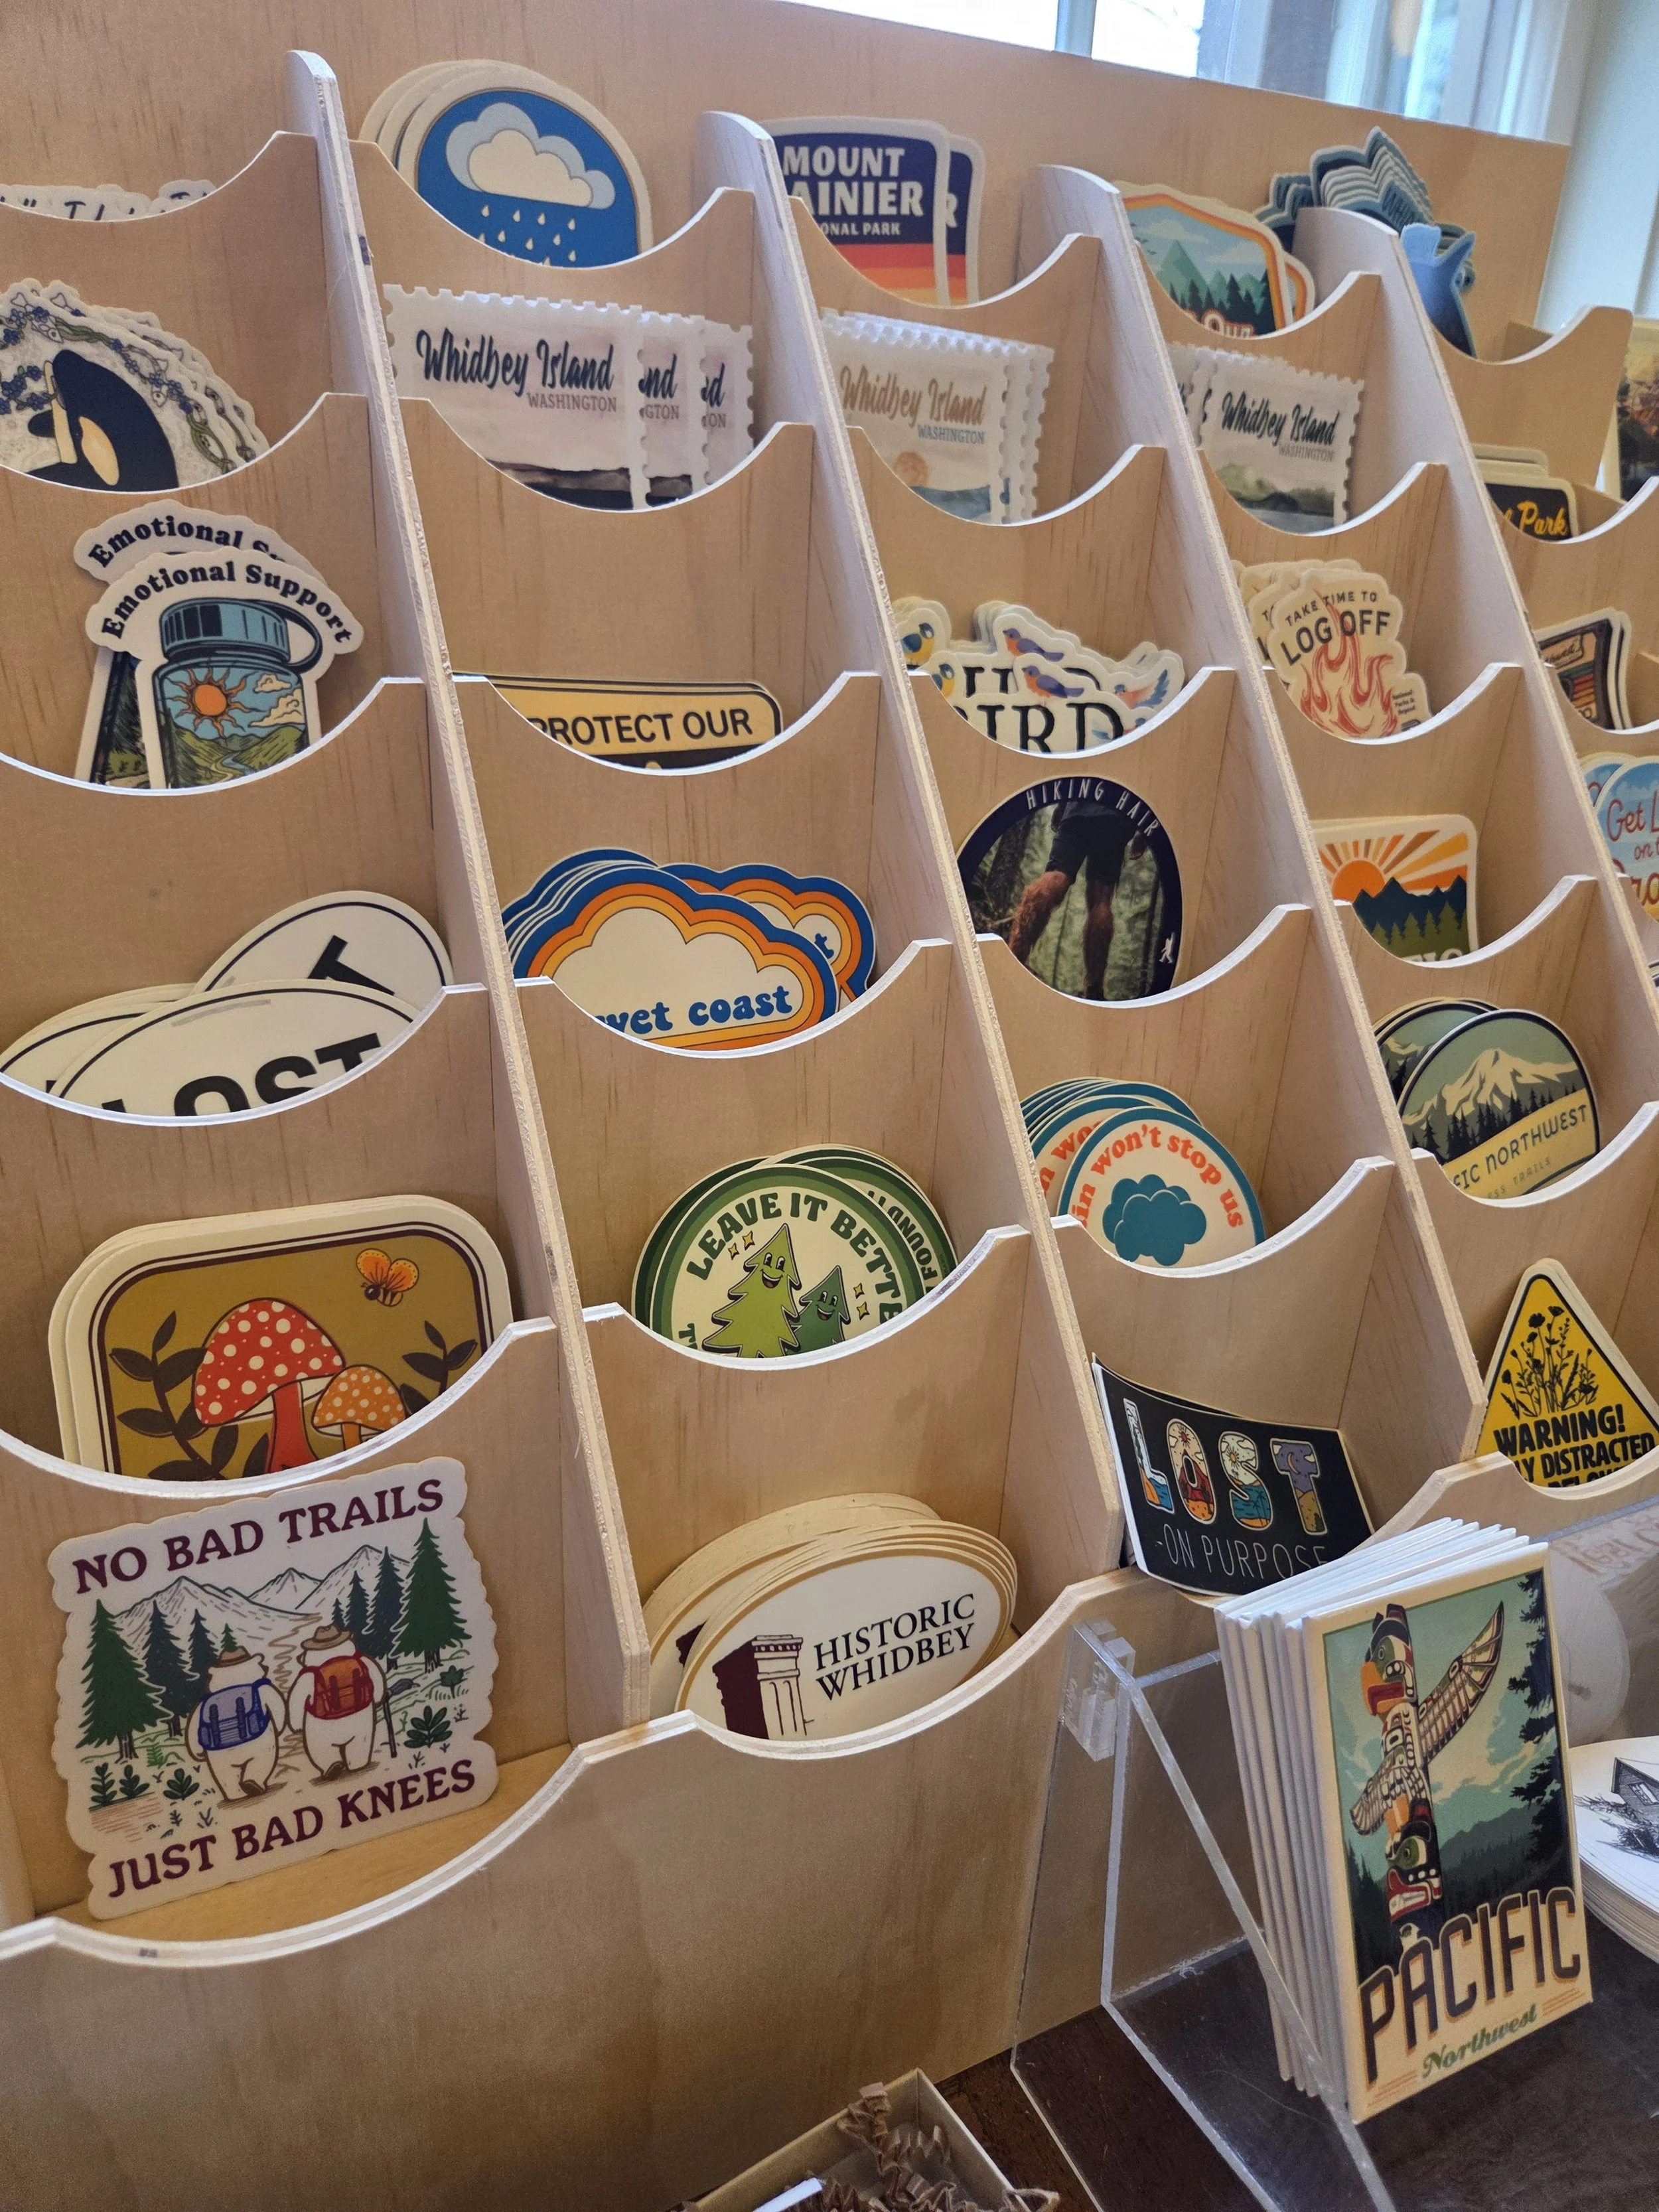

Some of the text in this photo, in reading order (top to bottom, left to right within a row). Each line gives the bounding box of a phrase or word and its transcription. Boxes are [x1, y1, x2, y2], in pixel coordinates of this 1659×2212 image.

[783, 145, 905, 177] MOUNT
[863, 222, 901, 236] PARK
[415, 327, 528, 398] Whidbey
[536, 338, 614, 392] Island
[527, 392, 617, 413] WASHINGTON
[839, 364, 988, 427] Whidbey Island
[1221, 390, 1340, 447] Whidbey Island
[917, 423, 986, 445] WASHINGTON
[1278, 441, 1335, 463] WASHINGTON
[88, 515, 244, 568] Emotional
[1517, 500, 1568, 536] Park
[102, 561, 354, 644] Emotional Support
[1285, 591, 1378, 627] TAKE TIME TO
[1280, 617, 1333, 666] LOG
[1339, 610, 1390, 636] OFF
[682, 708, 753, 739] OUR
[954, 702, 1124, 753] IRD
[1026, 778, 1161, 837] HIKING HAIR
[1607, 798, 1646, 842] Get
[688, 985, 793, 1027] coast
[102, 1032, 382, 1116] OST
[1090, 1124, 1161, 1175] won't
[1167, 1134, 1222, 1185] stop
[1219, 1189, 1244, 1228] us
[1512, 1157, 1551, 1186] TRAILS
[686, 1192, 782, 1281] LEAVE
[790, 1191, 828, 1222] IT
[1493, 1403, 1626, 1457] WARNING!
[1540, 1432, 1656, 1479] DISTRACTED
[1123, 1397, 1328, 1536] LOST
[72, 1479, 444, 1594] NO BAD TRAILS
[814, 1593, 975, 1671] HISTORIC
[816, 1623, 975, 1701] WHIDBEY
[108, 1759, 476, 1898] JUST BAD KNEES
[1358, 1886, 1581, 2089] PACIFIC
[1422, 2003, 1538, 2079] Northwest
